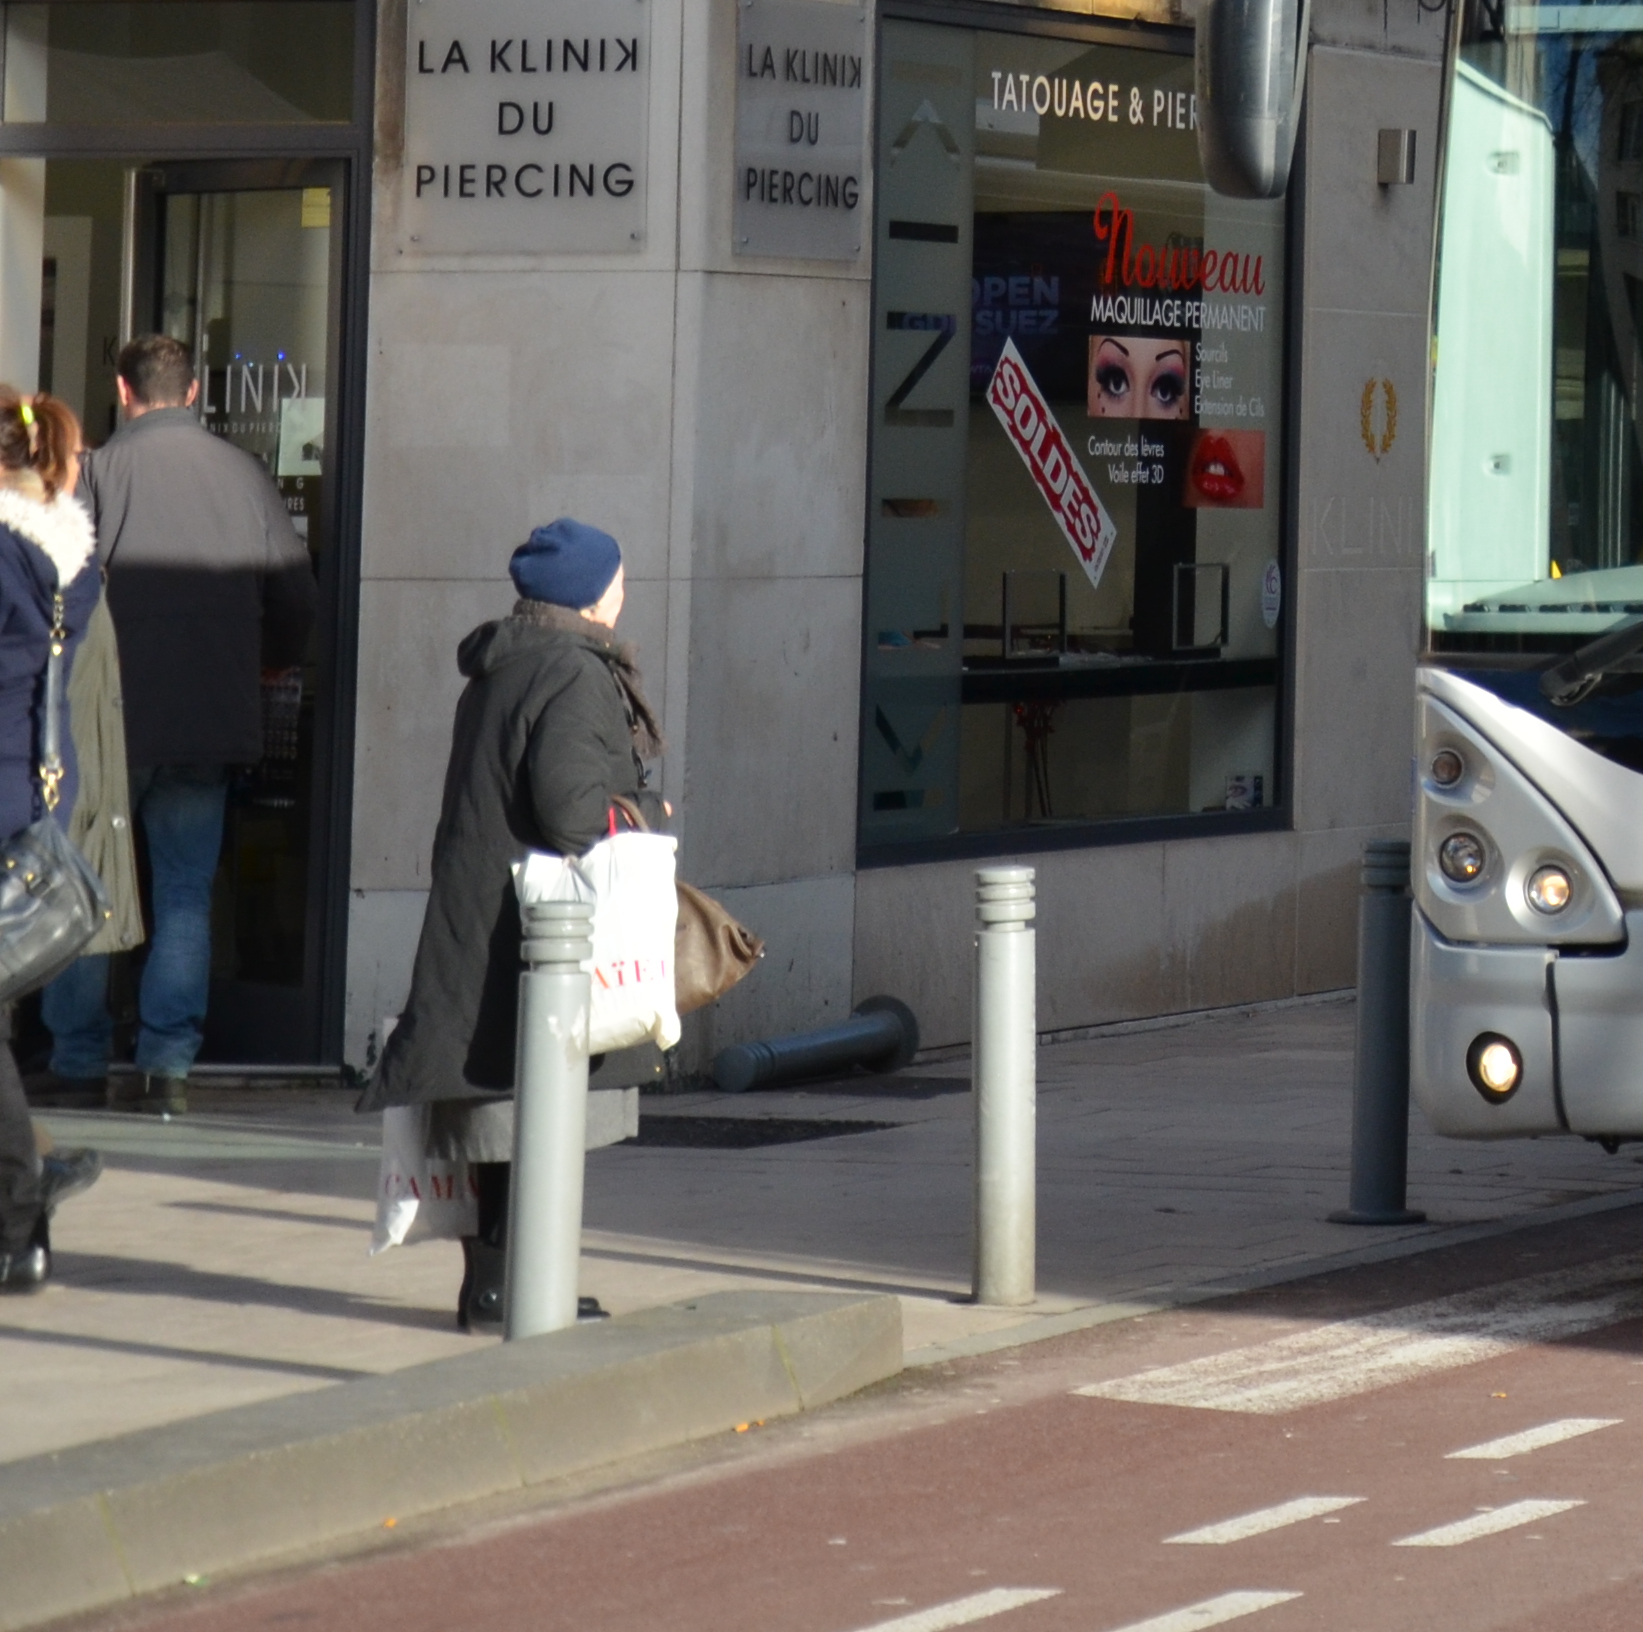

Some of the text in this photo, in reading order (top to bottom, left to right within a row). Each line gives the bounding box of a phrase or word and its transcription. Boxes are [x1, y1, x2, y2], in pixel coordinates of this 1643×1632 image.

[418, 38, 640, 74] LA KLINIK
[747, 41, 863, 90] LA KLINIK
[991, 71, 1119, 124] TATOUAGE
[1128, 90, 1145, 126] &
[497, 101, 555, 136] DU
[789, 110, 820, 147] DU
[416, 163, 636, 200] PIERCING
[744, 167, 860, 211] PIERCING
[1090, 294, 1267, 332] MAQUILLAGE PERMANENT
[995, 361, 1099, 551] SOLDES
[1088, 435, 1165, 459] Contour des lèvres
[1108, 463, 1165, 485] Voile effet 3D
